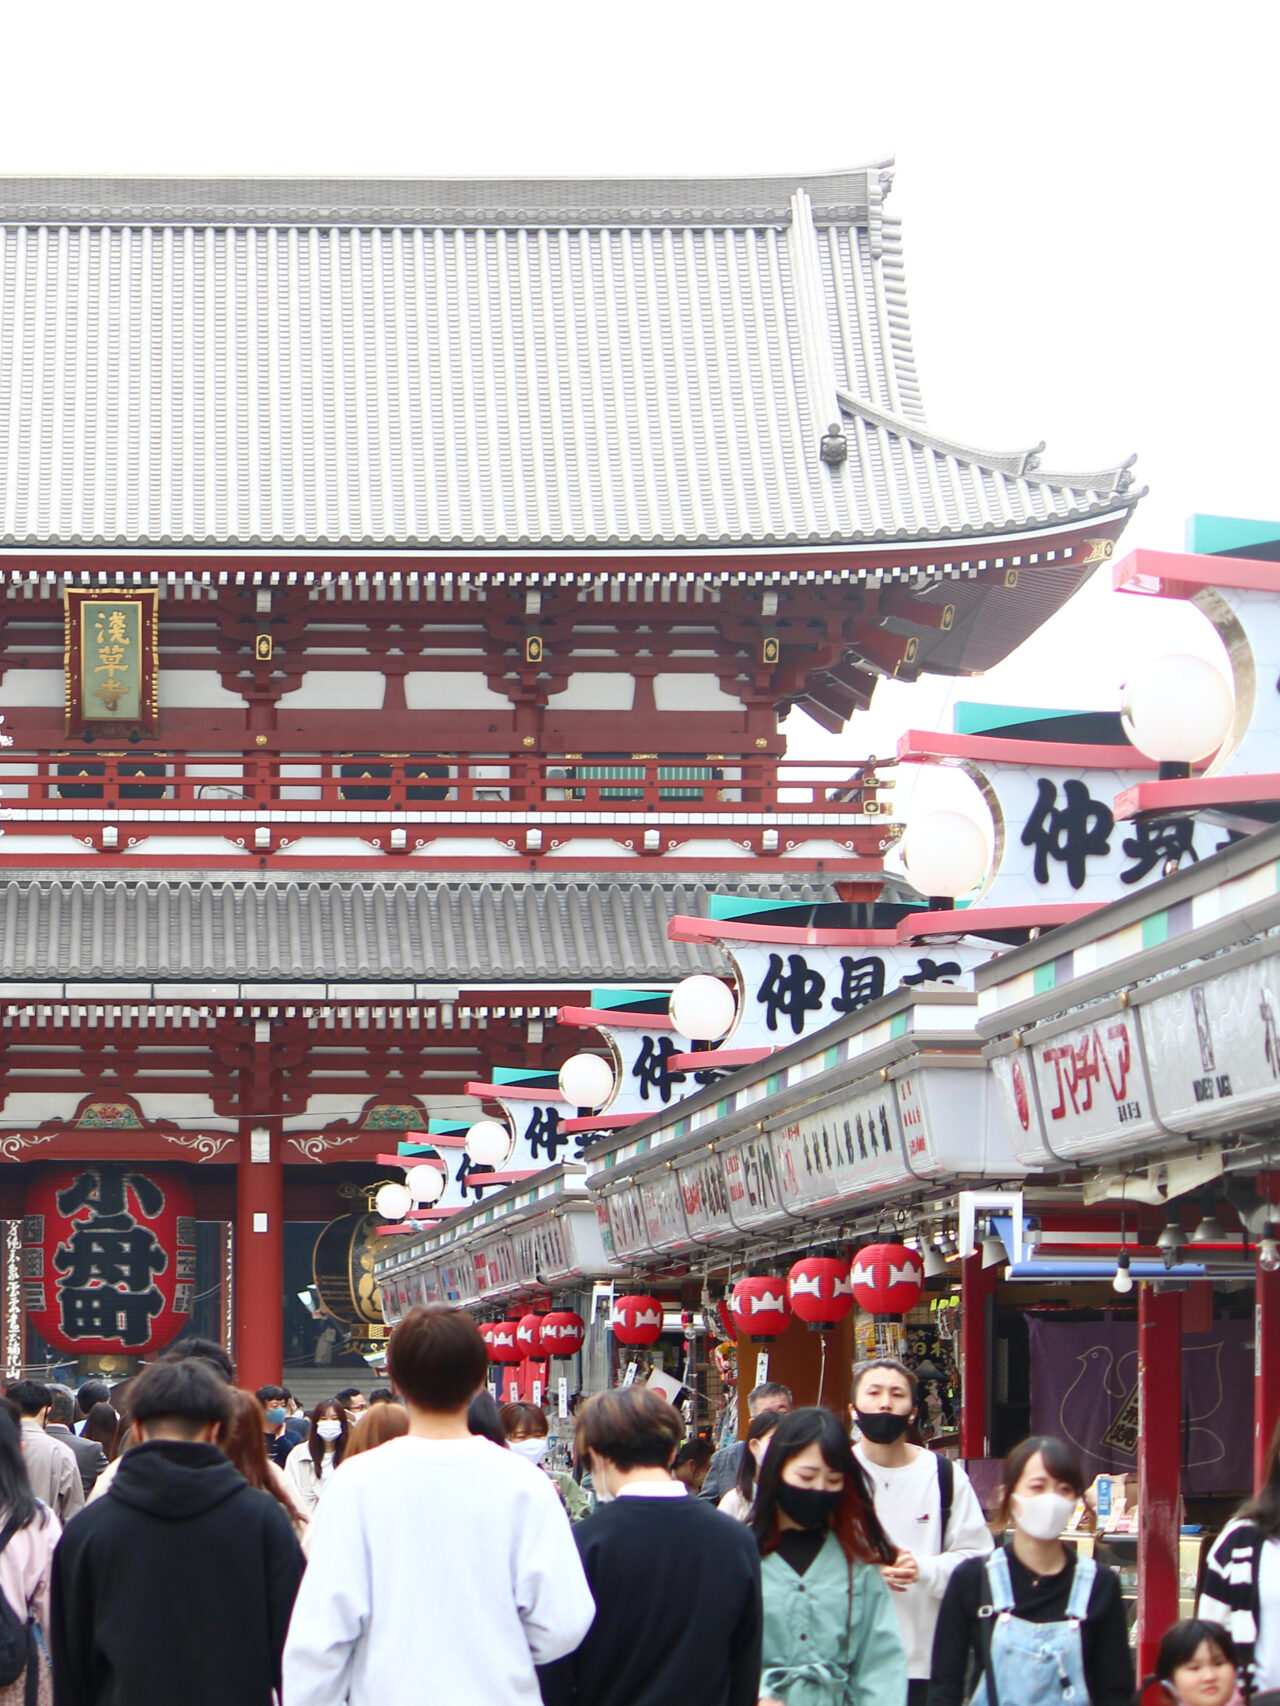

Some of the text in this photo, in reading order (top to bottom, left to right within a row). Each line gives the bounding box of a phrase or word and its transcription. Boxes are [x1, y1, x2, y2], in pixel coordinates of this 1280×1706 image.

[1043, 1022, 1130, 1120] コマチヘア
